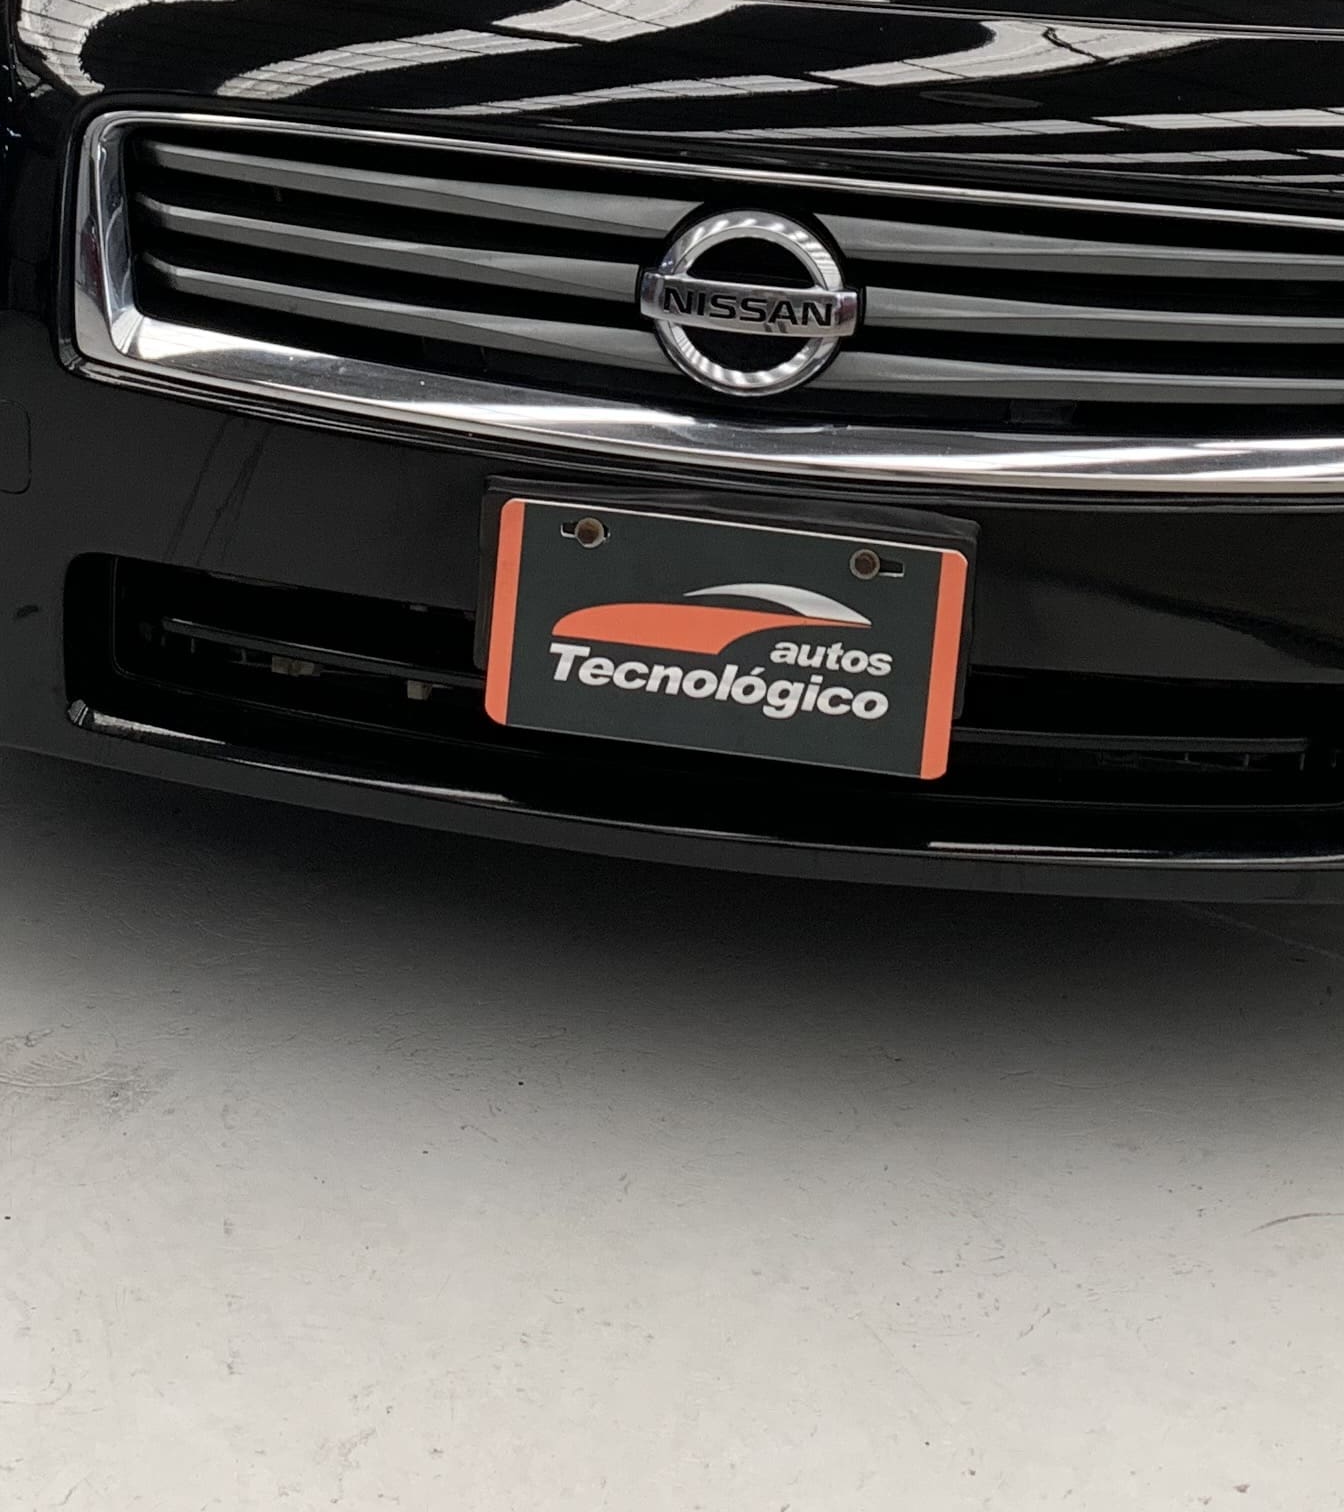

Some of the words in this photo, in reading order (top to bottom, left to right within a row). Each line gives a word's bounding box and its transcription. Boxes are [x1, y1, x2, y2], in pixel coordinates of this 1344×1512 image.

[663, 287, 834, 327] NISSAN
[770, 641, 894, 676] autos
[549, 642, 889, 720] Tecnológico
